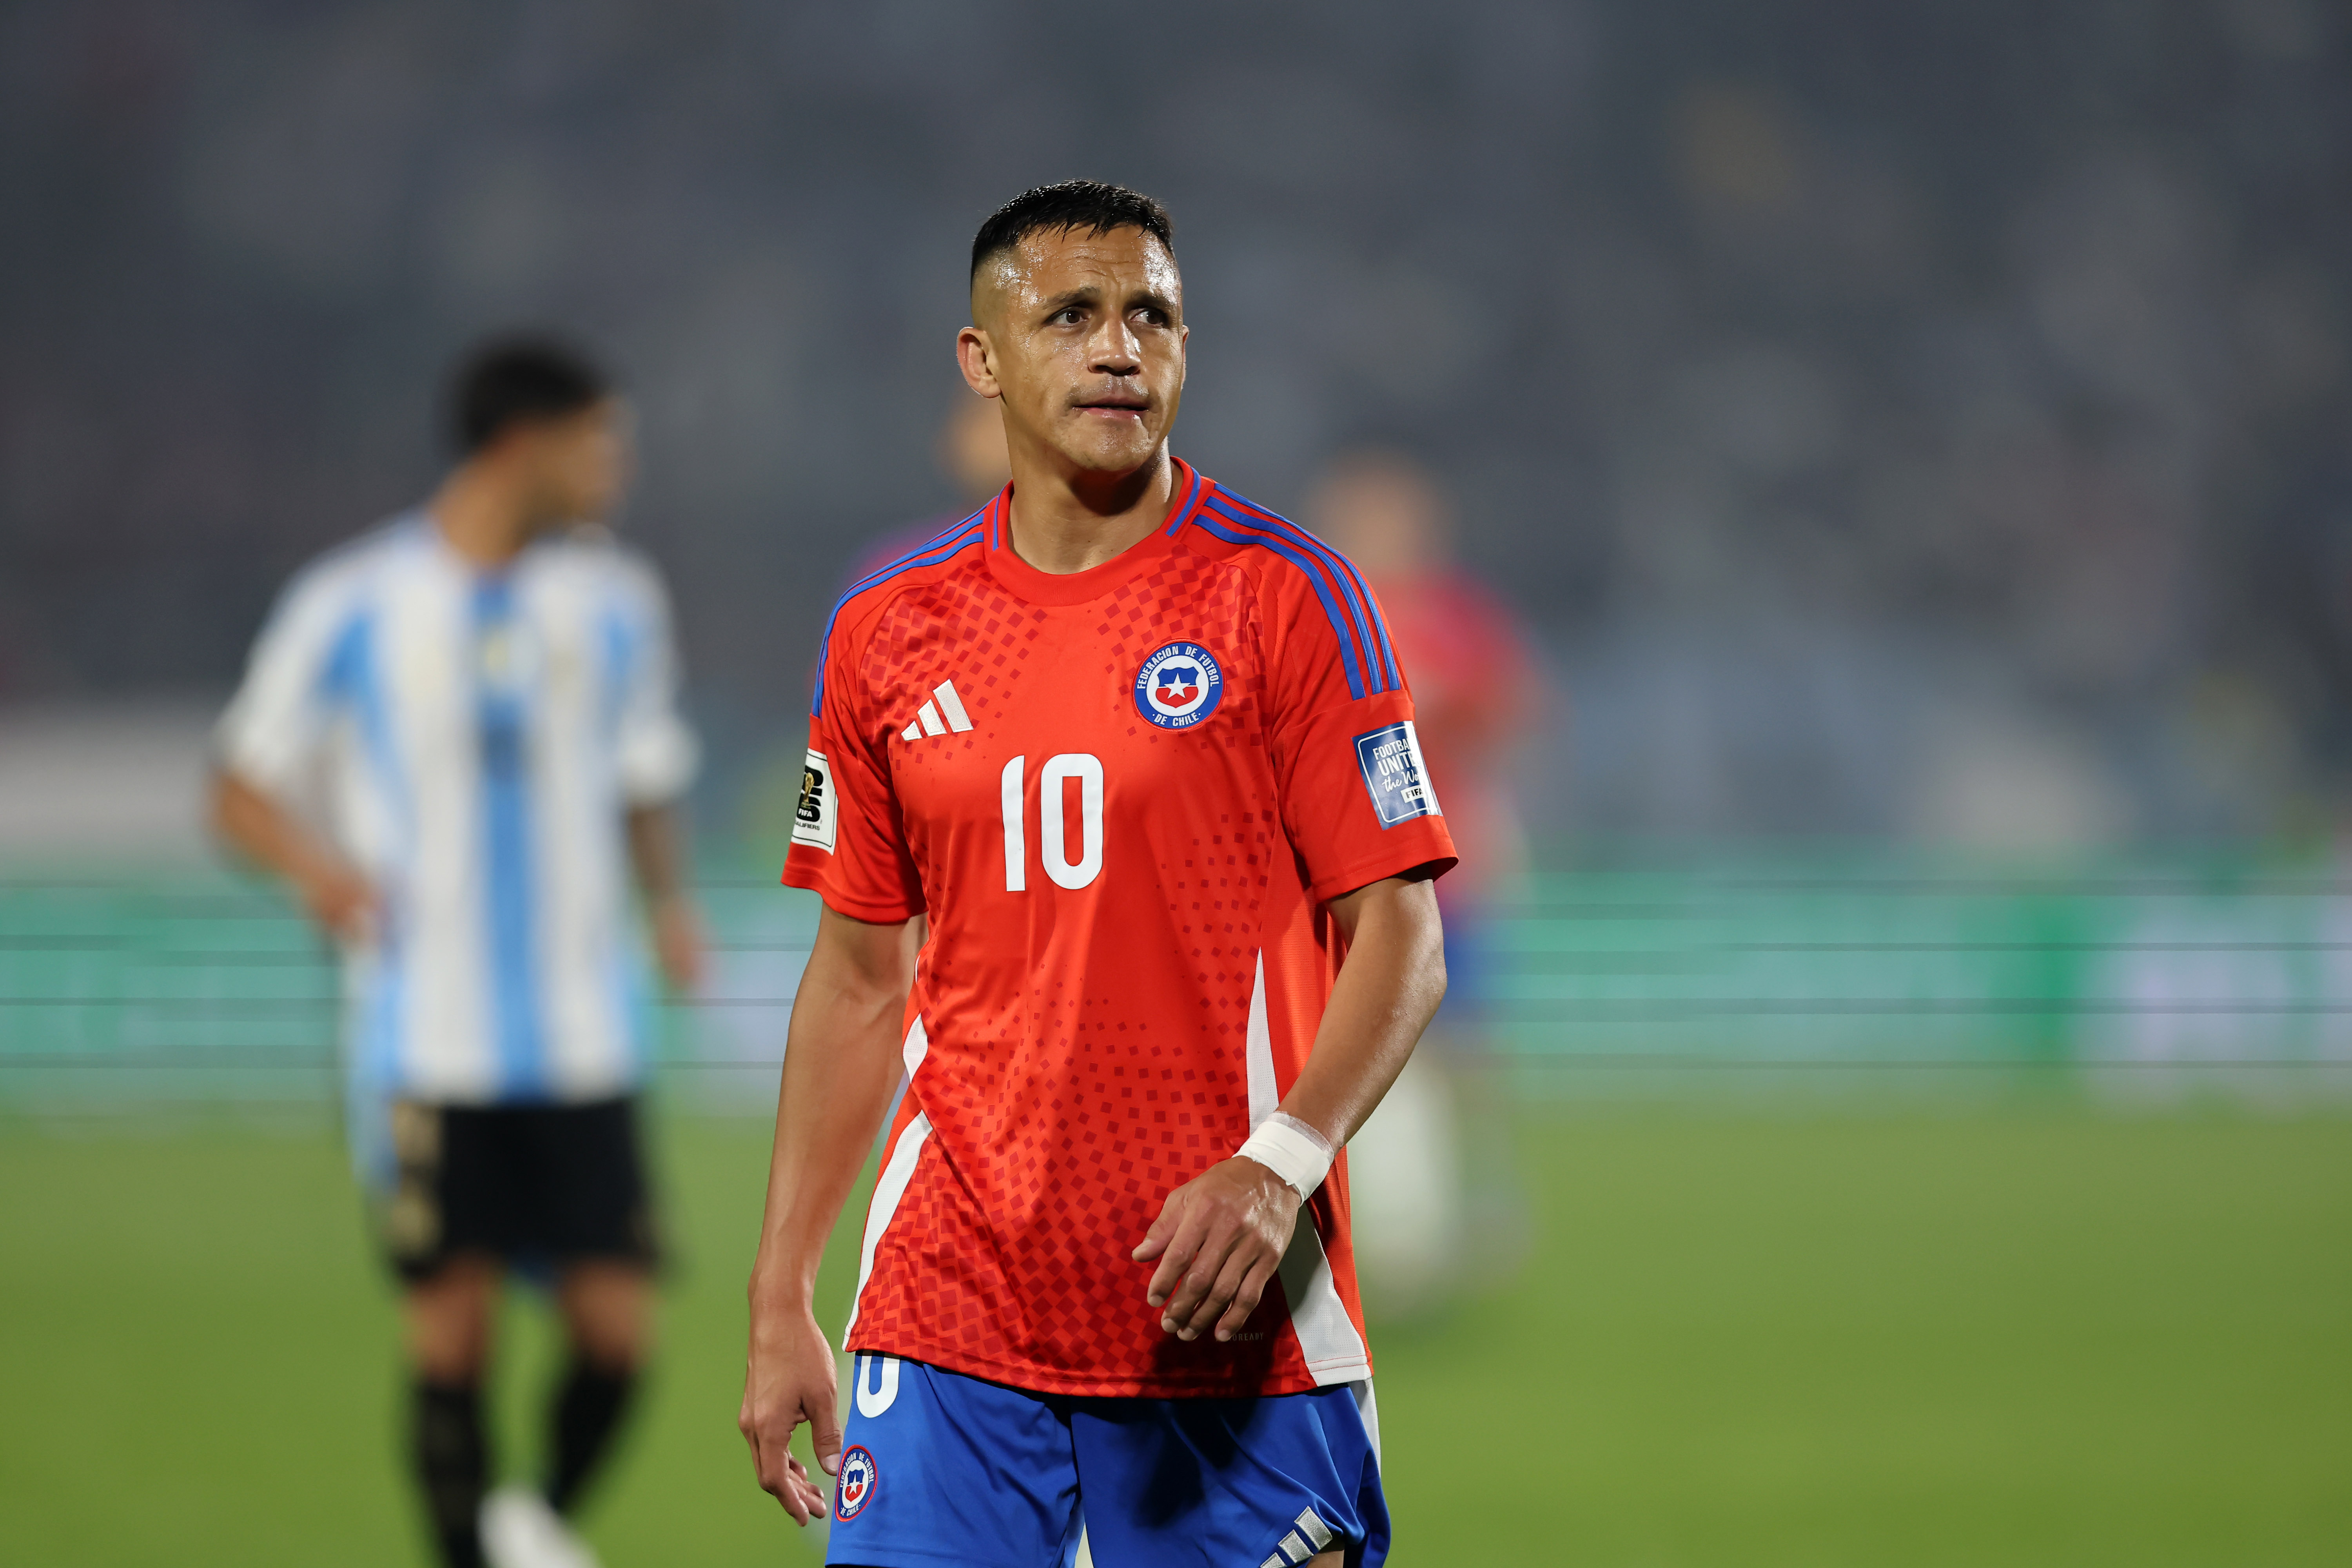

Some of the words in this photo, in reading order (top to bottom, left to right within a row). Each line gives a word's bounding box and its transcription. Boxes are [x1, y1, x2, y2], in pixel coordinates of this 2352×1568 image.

[1137, 646, 1179, 689] FEDERACION
[1185, 646, 1198, 657] DE
[1198, 653, 1220, 687] FUTBOL
[1154, 713, 1167, 725] DE
[1172, 712, 1200, 726] CHILE
[1373, 738, 1412, 760] FOOTBA
[1377, 751, 1418, 777] UNITE
[1382, 775, 1402, 793] the
[1405, 788, 1423, 799] FIFA
[798, 808, 813, 818] FIFA
[1001, 753, 1104, 892] 10
[1229, 1332, 1264, 1341] OREADY
[840, 1452, 857, 1488] FEDERACION
[858, 1452, 865, 1461] DE
[864, 1458, 874, 1484] FUTBOL
[840, 1507, 846, 1516] DE
[846, 1504, 860, 1517] CHILE
